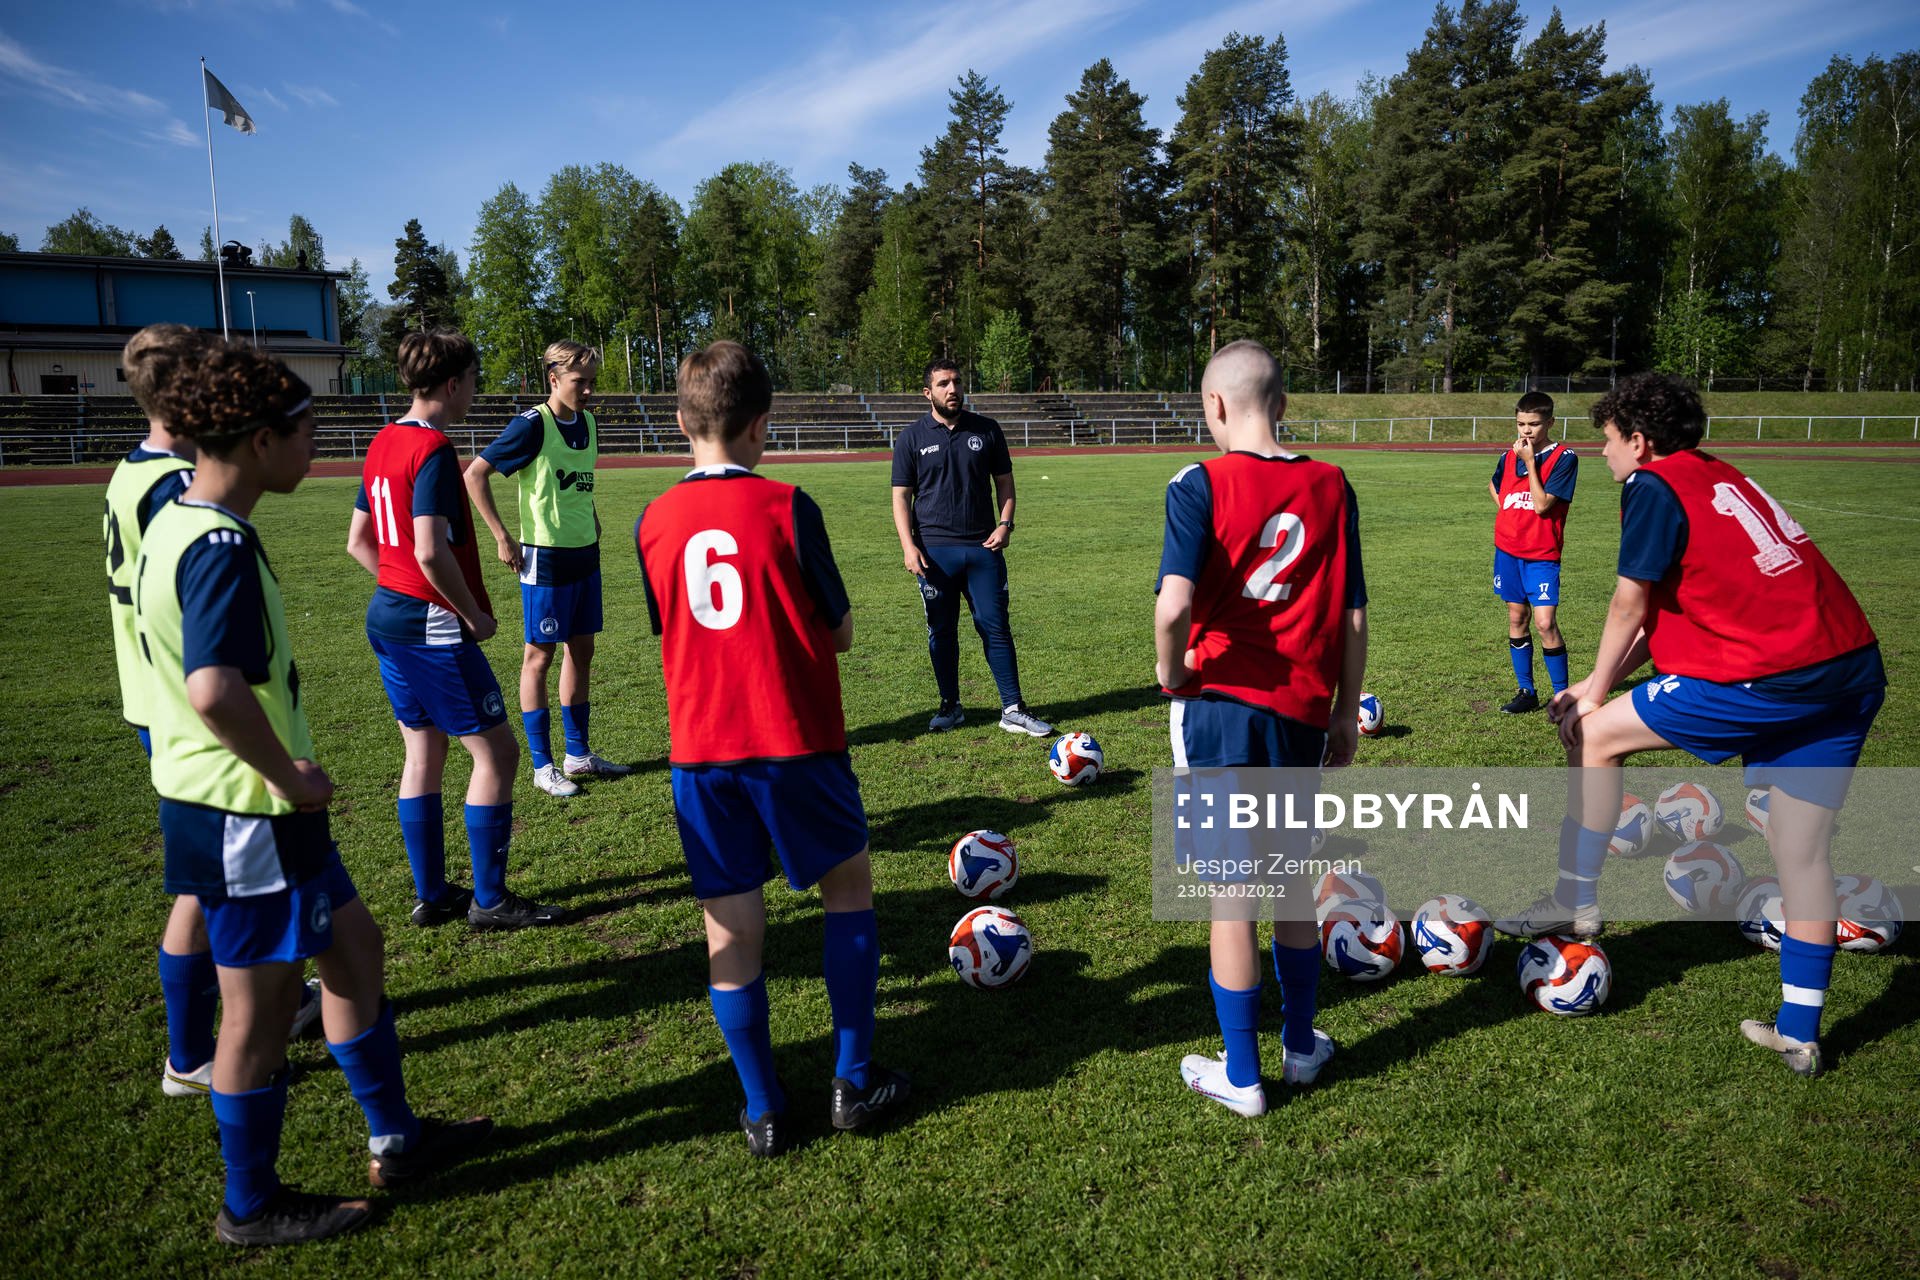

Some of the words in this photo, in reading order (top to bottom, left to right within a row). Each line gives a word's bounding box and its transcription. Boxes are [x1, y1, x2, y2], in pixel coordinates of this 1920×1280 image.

[371, 476, 399, 546] 11
[684, 528, 743, 630] 6
[1242, 512, 1306, 602] 2
[1538, 582, 1550, 593] 17
[1660, 674, 1681, 694] 14
